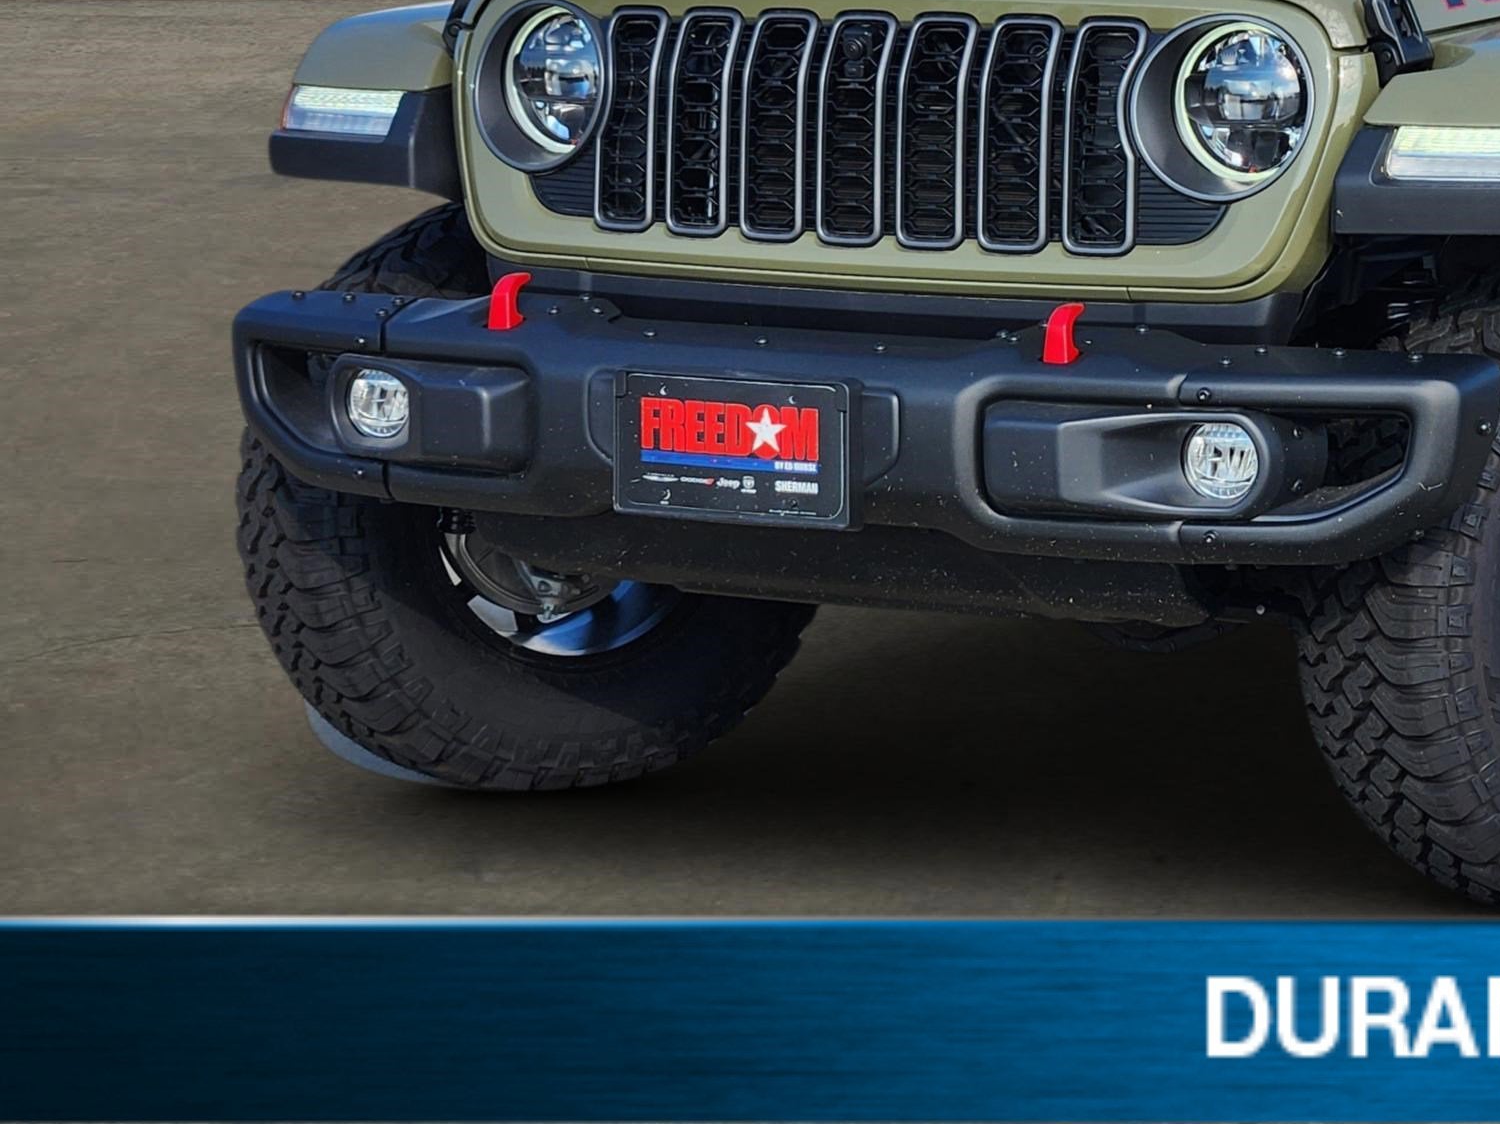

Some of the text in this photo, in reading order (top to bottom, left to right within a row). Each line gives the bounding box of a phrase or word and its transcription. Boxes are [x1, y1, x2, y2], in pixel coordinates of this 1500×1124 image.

[641, 397, 819, 461] FREEDOM
[716, 476, 741, 490] Jeep
[775, 480, 818, 494] SHERMAN
